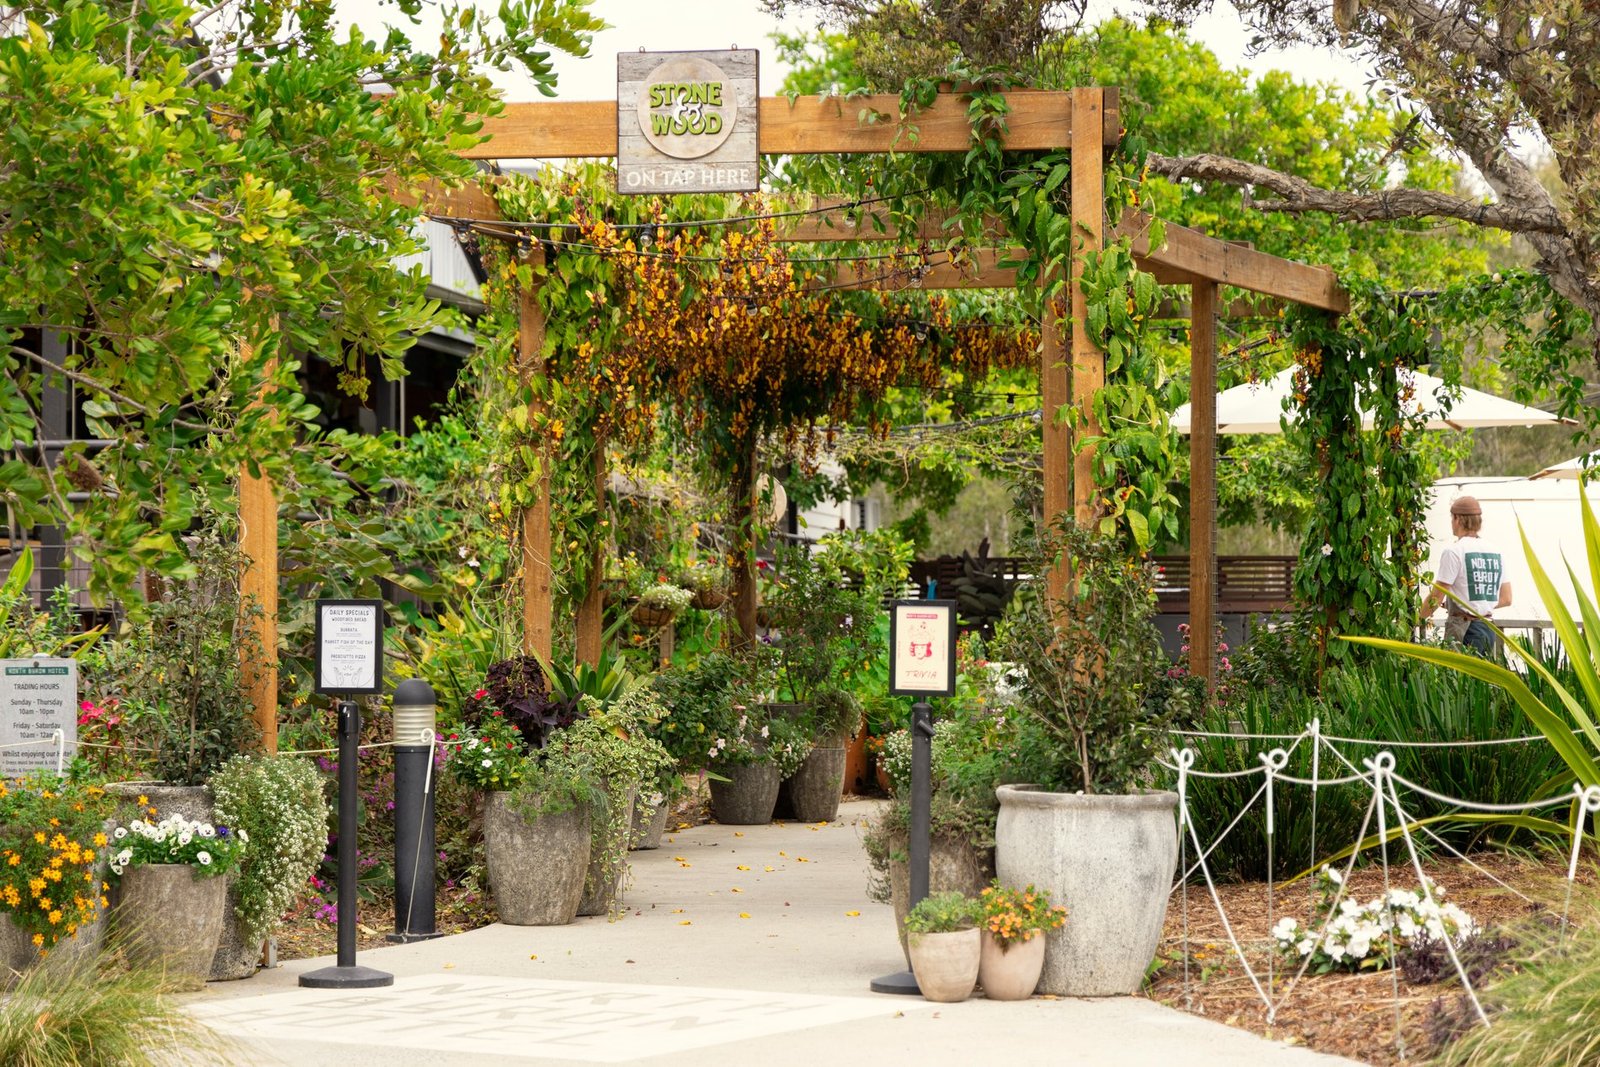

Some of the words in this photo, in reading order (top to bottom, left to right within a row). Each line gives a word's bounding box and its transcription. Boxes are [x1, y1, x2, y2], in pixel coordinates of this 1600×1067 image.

[648, 82, 723, 108] STONE
[649, 112, 723, 136] WOOD
[626, 169, 656, 187] ON
[660, 169, 696, 186] TAP
[701, 168, 750, 185] HERE
[1470, 557, 1500, 570] NORTH
[905, 670, 937, 679] TRIVIA
[10, 698, 32, 707] Sunday
[37, 698, 63, 707] Thursday
[39, 708, 55, 716] 10pm
[13, 722, 30, 730] Friday
[2, 750, 20, 758] Whilst
[21, 750, 46, 759] enjoying
